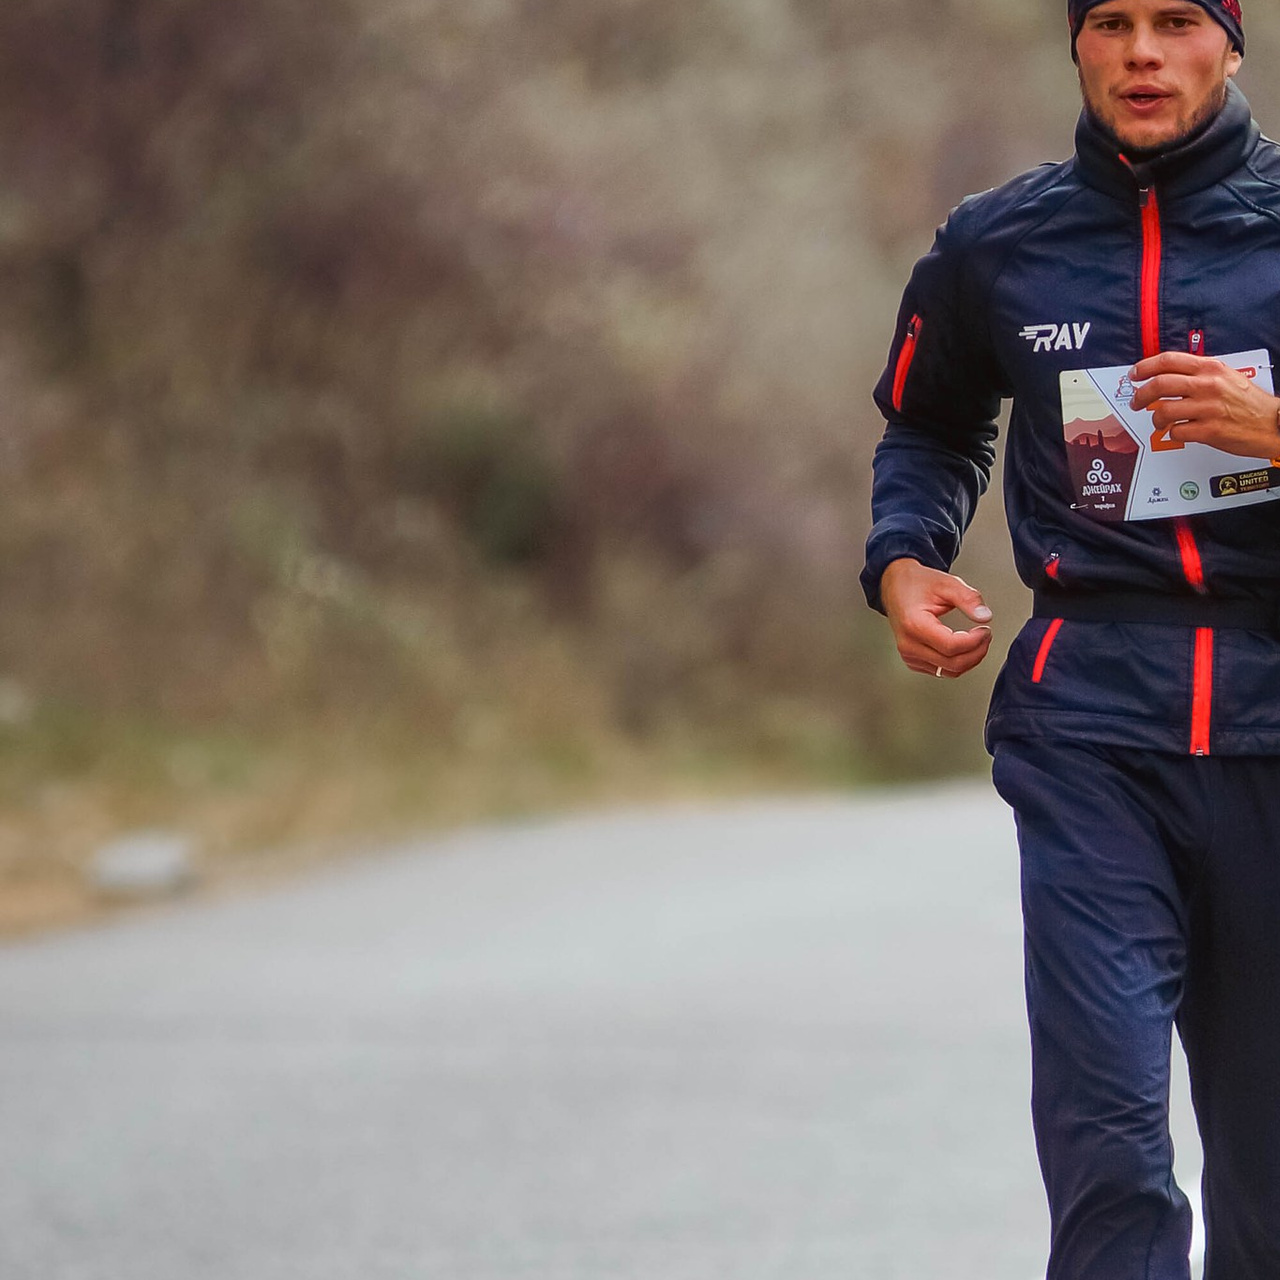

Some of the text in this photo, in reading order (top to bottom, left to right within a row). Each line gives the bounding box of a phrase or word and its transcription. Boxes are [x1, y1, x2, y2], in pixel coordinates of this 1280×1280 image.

[1019, 322, 1090, 352] RAV
[1239, 475, 1269, 486] UNITED
[1082, 483, 1122, 496] ДЖЕЙРАХ
